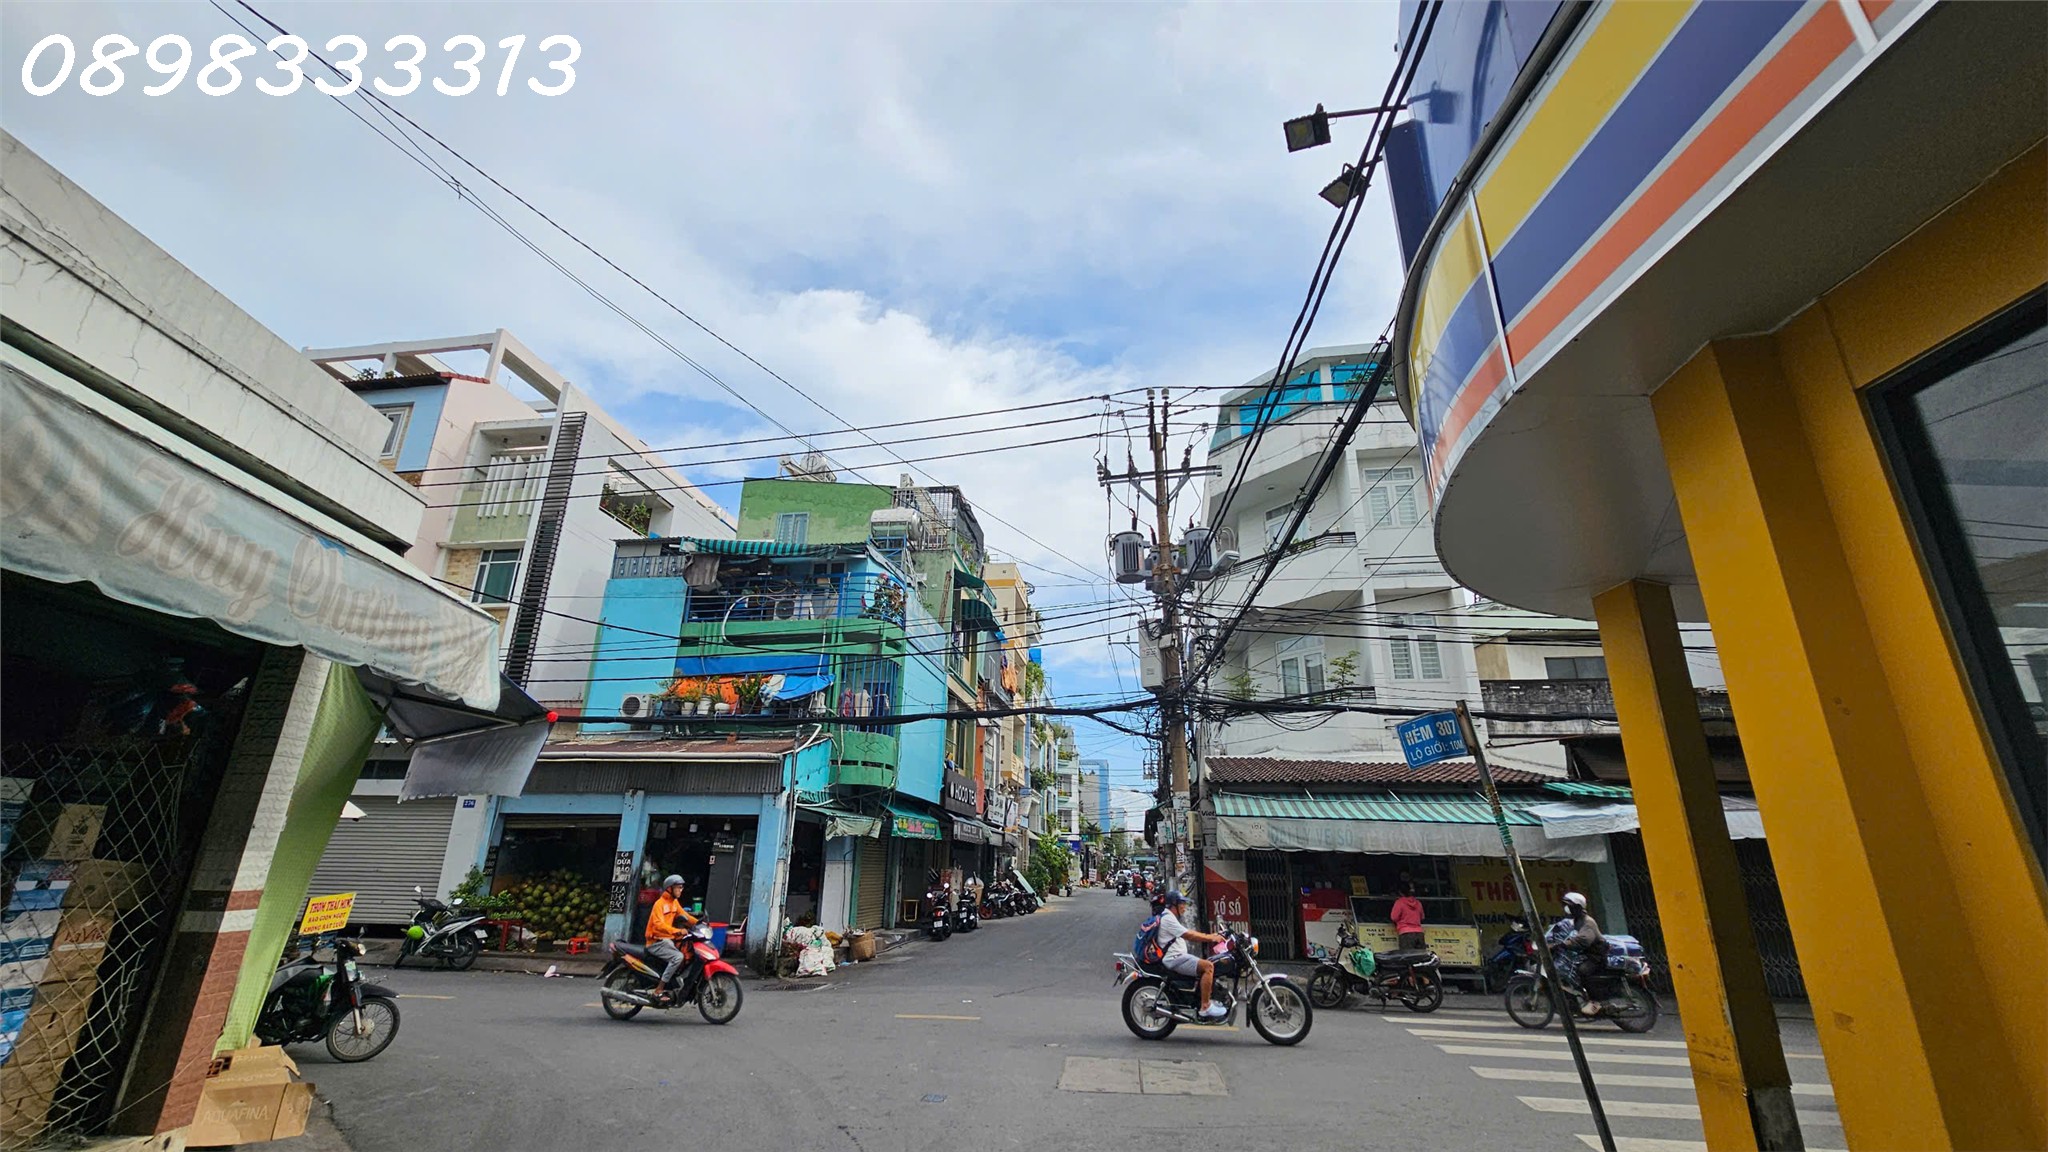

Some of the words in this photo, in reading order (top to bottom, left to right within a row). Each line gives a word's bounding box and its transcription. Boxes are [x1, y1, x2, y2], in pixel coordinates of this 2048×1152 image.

[1405, 723, 1434, 746] HẺM
[1436, 720, 1457, 737] 307
[1213, 895, 1226, 915] XỔ
[1228, 896, 1242, 916] SỐ
[203, 1105, 269, 1121] AQUAFINA
